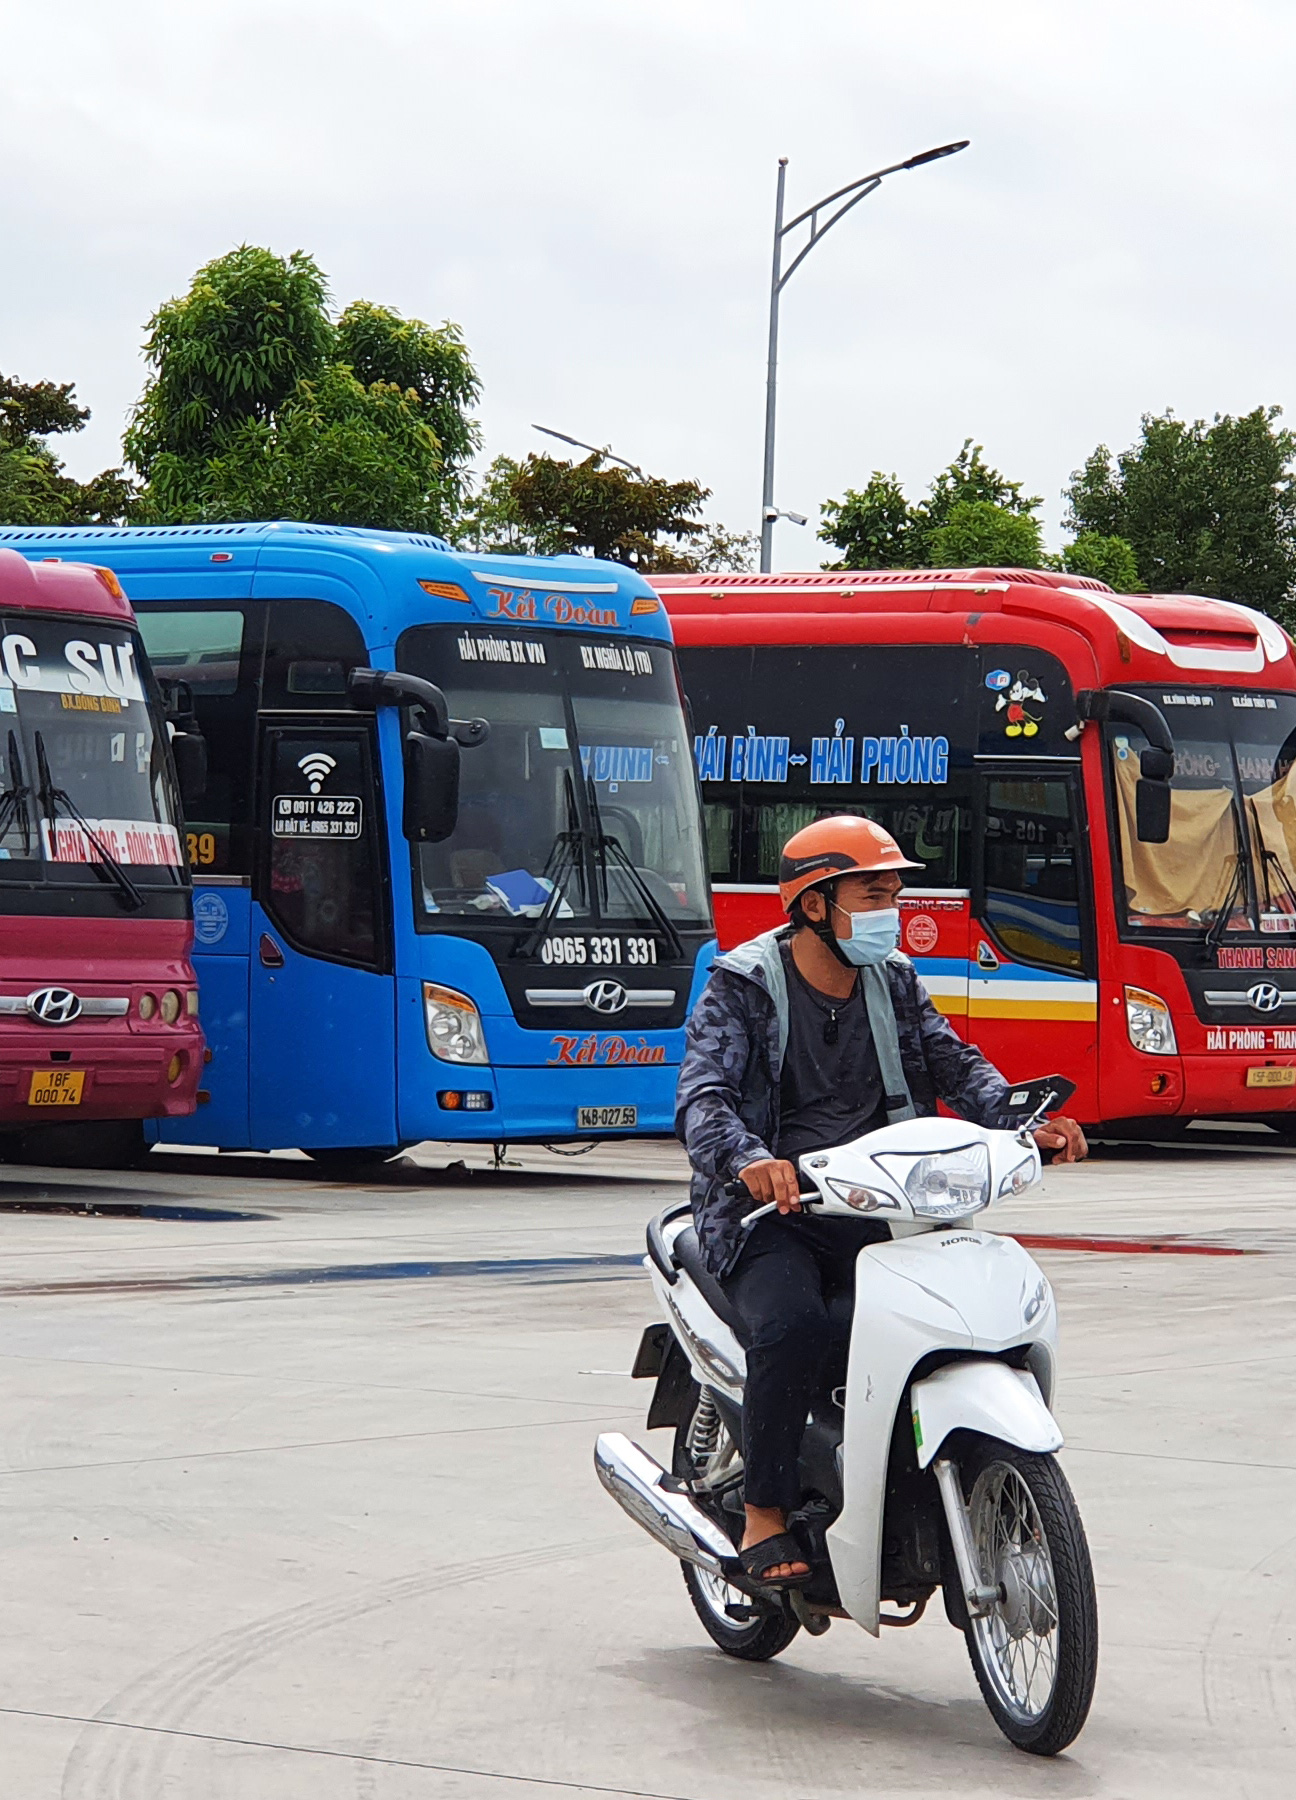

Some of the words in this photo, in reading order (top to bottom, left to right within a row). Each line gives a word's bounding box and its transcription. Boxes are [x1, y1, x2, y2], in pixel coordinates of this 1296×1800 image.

[487, 588, 538, 620] Kết
[544, 595, 620, 627] Đoàn
[458, 630, 478, 660] HẢI
[477, 635, 512, 662] PHÒNG
[511, 640, 527, 663] BX
[526, 642, 547, 664] VN
[580, 645, 598, 669] BX
[730, 725, 789, 783] BÌNH
[810, 718, 854, 784] HẢI
[861, 724, 949, 784] PHÒNG
[293, 801, 315, 814] 0911
[317, 801, 335, 814] 426
[336, 801, 355, 815] 222
[542, 937, 587, 964] 0965
[590, 937, 622, 964] 331
[627, 938, 657, 965] 331
[1217, 947, 1264, 968] THANH
[547, 1033, 597, 1066] Kết
[598, 1035, 667, 1064] Đoàn
[1206, 1026, 1227, 1050] HẢI
[1228, 1028, 1265, 1050] PHÒNG
[49, 1073, 71, 1087] 18F
[35, 1089, 76, 1104] 000.74
